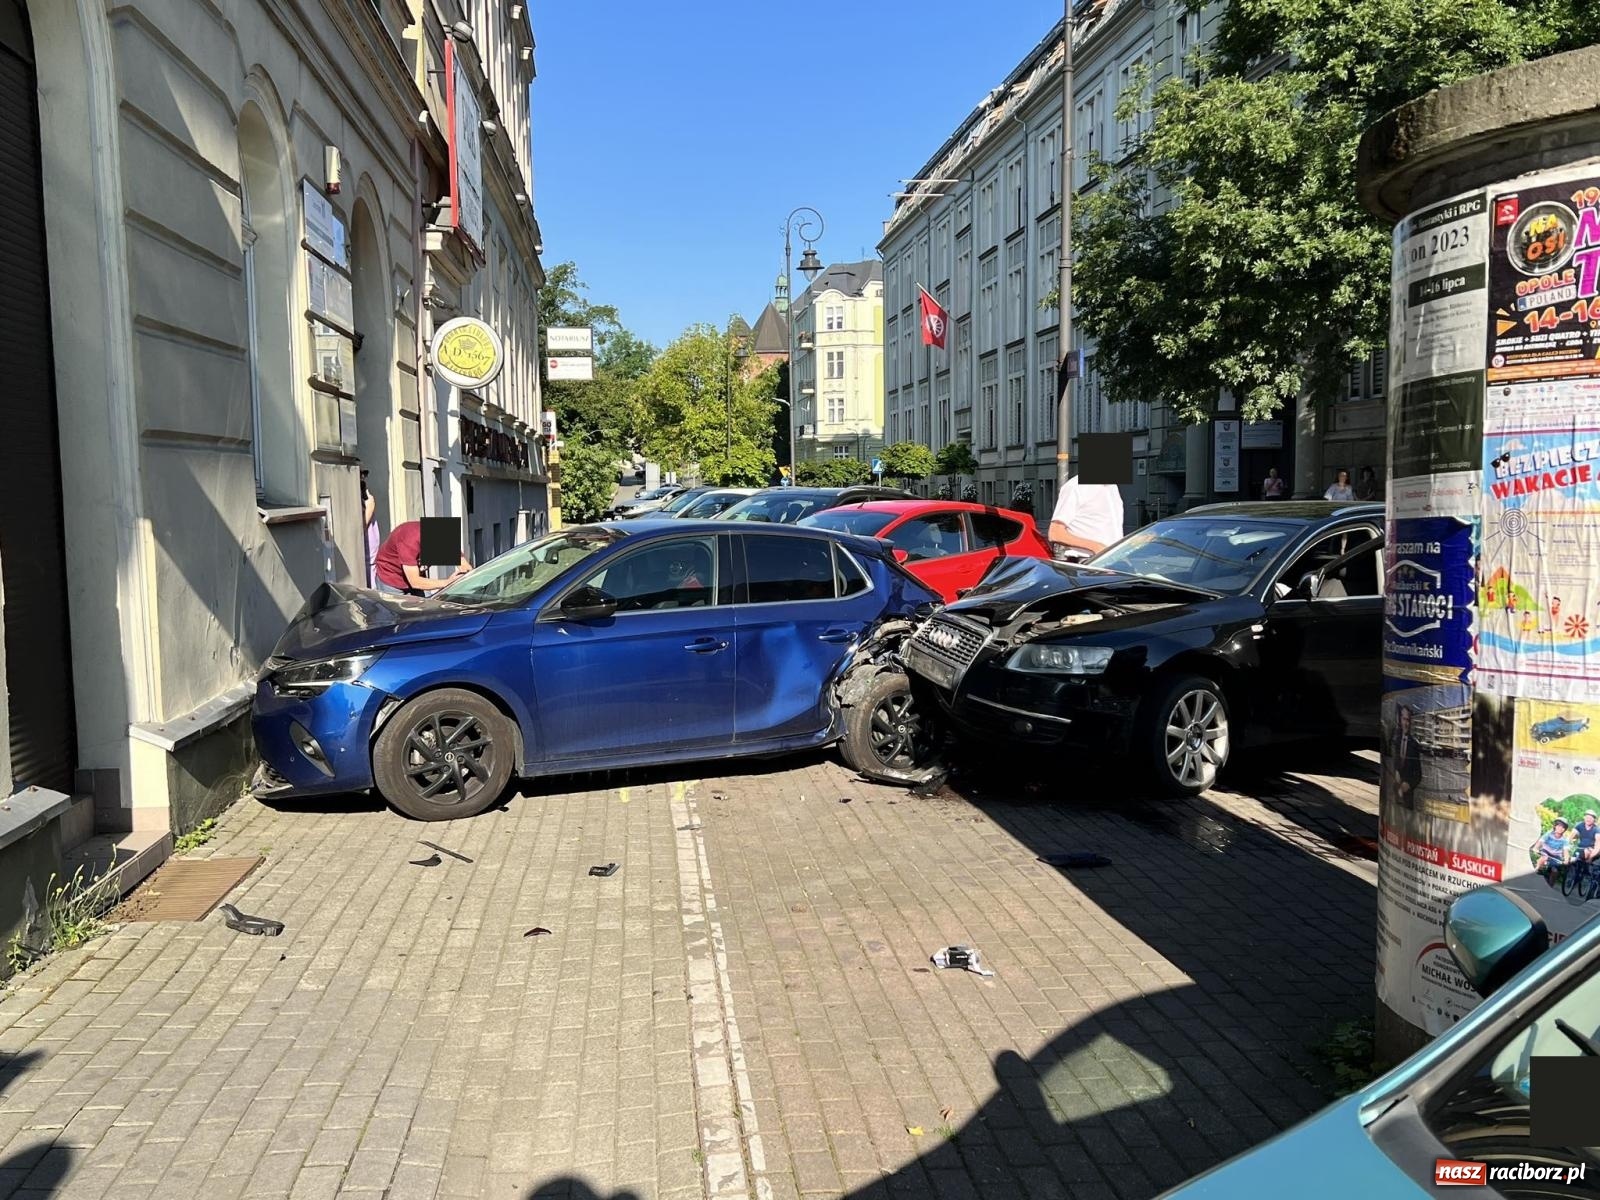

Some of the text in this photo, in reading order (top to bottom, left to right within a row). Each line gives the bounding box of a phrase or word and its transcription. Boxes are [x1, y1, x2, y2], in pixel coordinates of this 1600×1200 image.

[1459, 200, 1481, 215] RPG
[1432, 225, 1469, 255] 2023
[1442, 276, 1466, 290] lipca
[1516, 269, 1576, 296] OPOLE
[1529, 287, 1573, 306] POLAND
[1496, 337, 1523, 346] SMOKIE
[1549, 331, 1581, 341] QUATRO
[1496, 440, 1600, 480] BEZPIECZ
[1491, 464, 1591, 500] WAKACJE
[1426, 541, 1441, 554] na
[1412, 863, 1438, 879] PAŁACEM
[1440, 873, 1447, 881] W
[1452, 854, 1496, 878] ŚLĄSKICH
[1422, 964, 1452, 983] MICHAŁ
